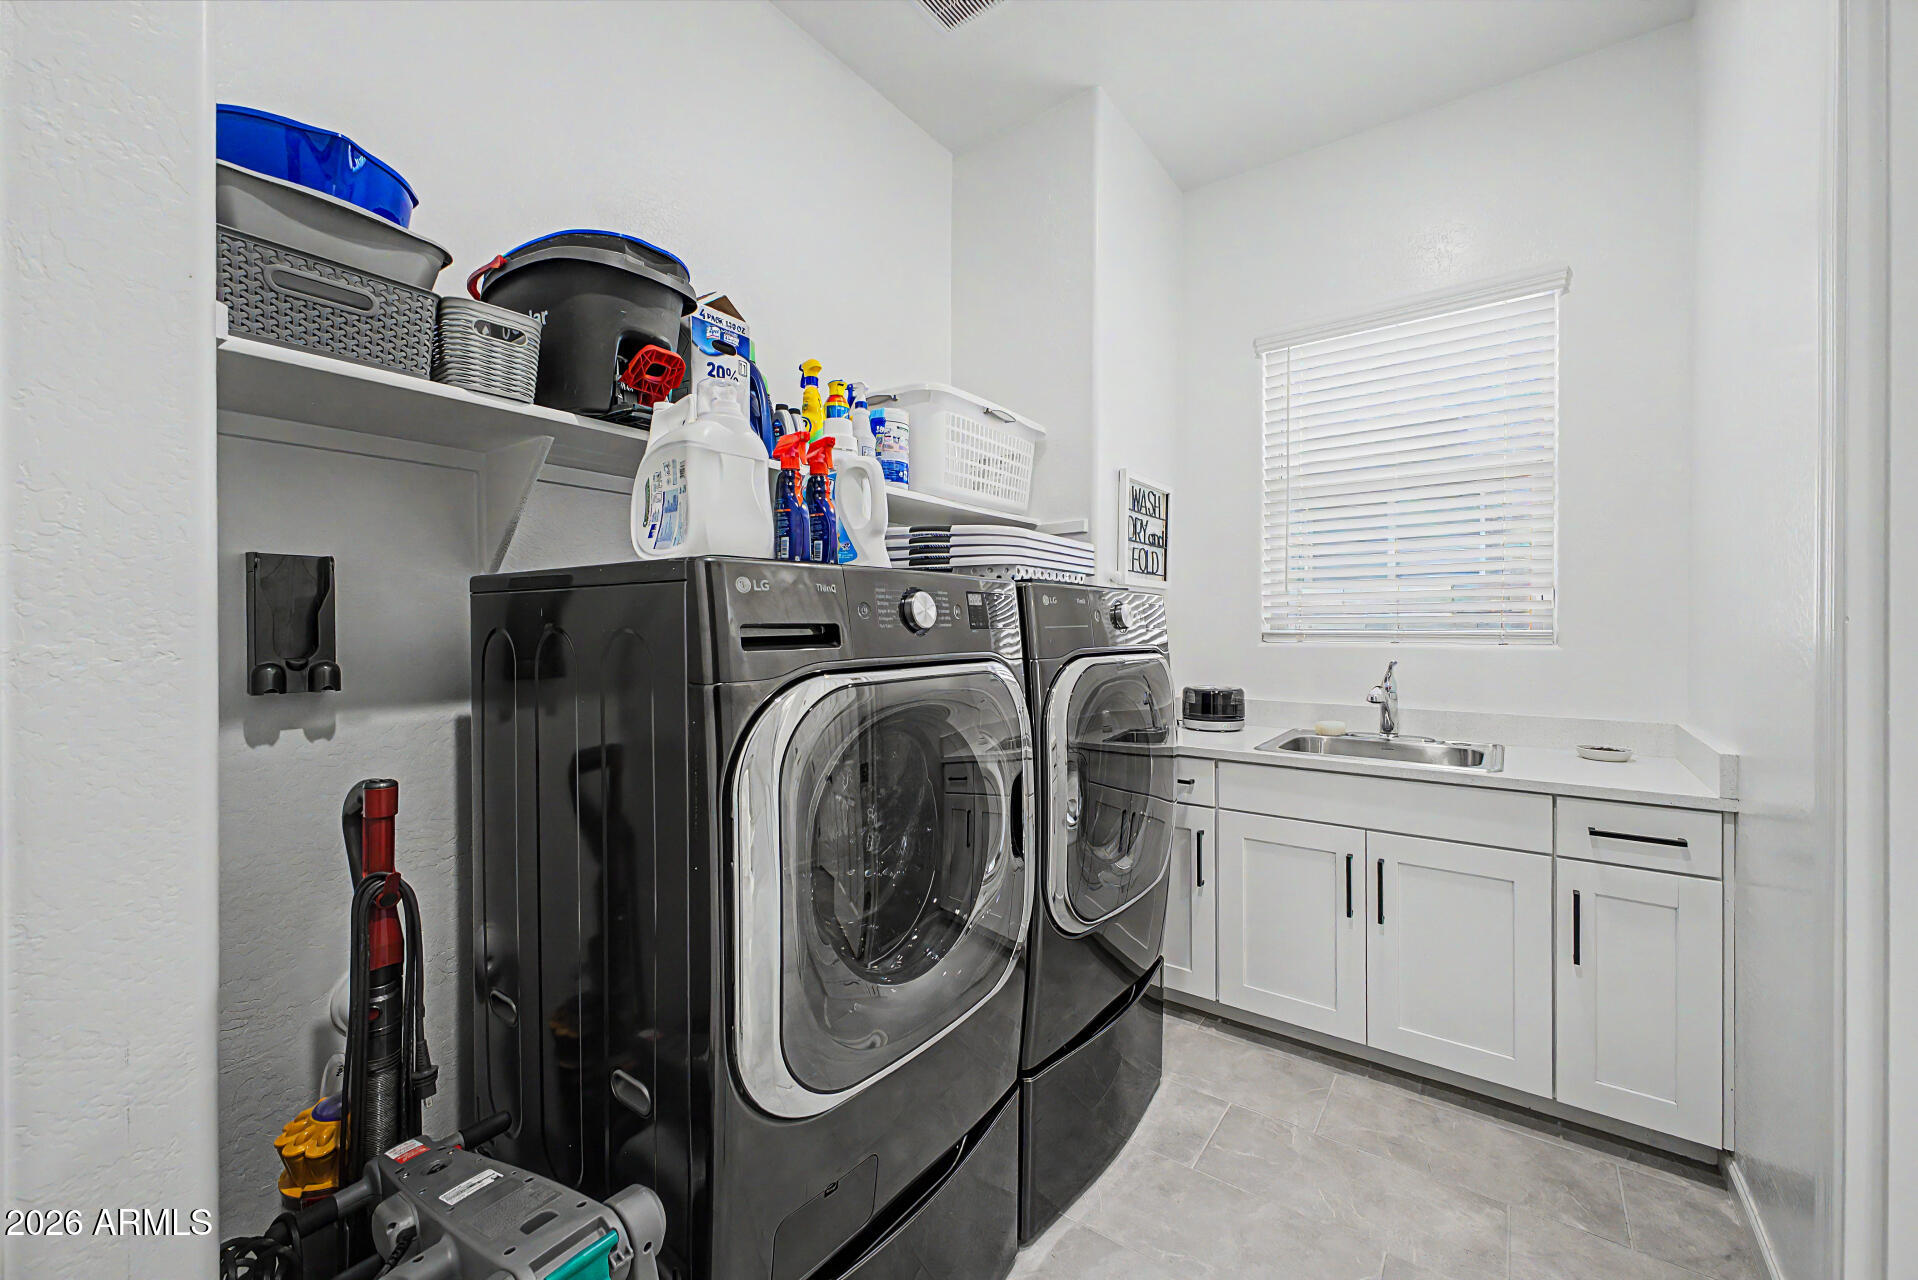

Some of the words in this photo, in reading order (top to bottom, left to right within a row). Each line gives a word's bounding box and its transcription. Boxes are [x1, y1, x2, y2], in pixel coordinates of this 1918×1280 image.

[699, 308, 706, 320] 4
[706, 361, 739, 382] 20%
[1131, 485, 1160, 518] WASH
[1128, 515, 1149, 544] DRY
[1148, 530, 1165, 547] and
[1131, 546, 1160, 575] FOLD
[753, 579, 770, 591] LG
[816, 583, 837, 593] ThinQ
